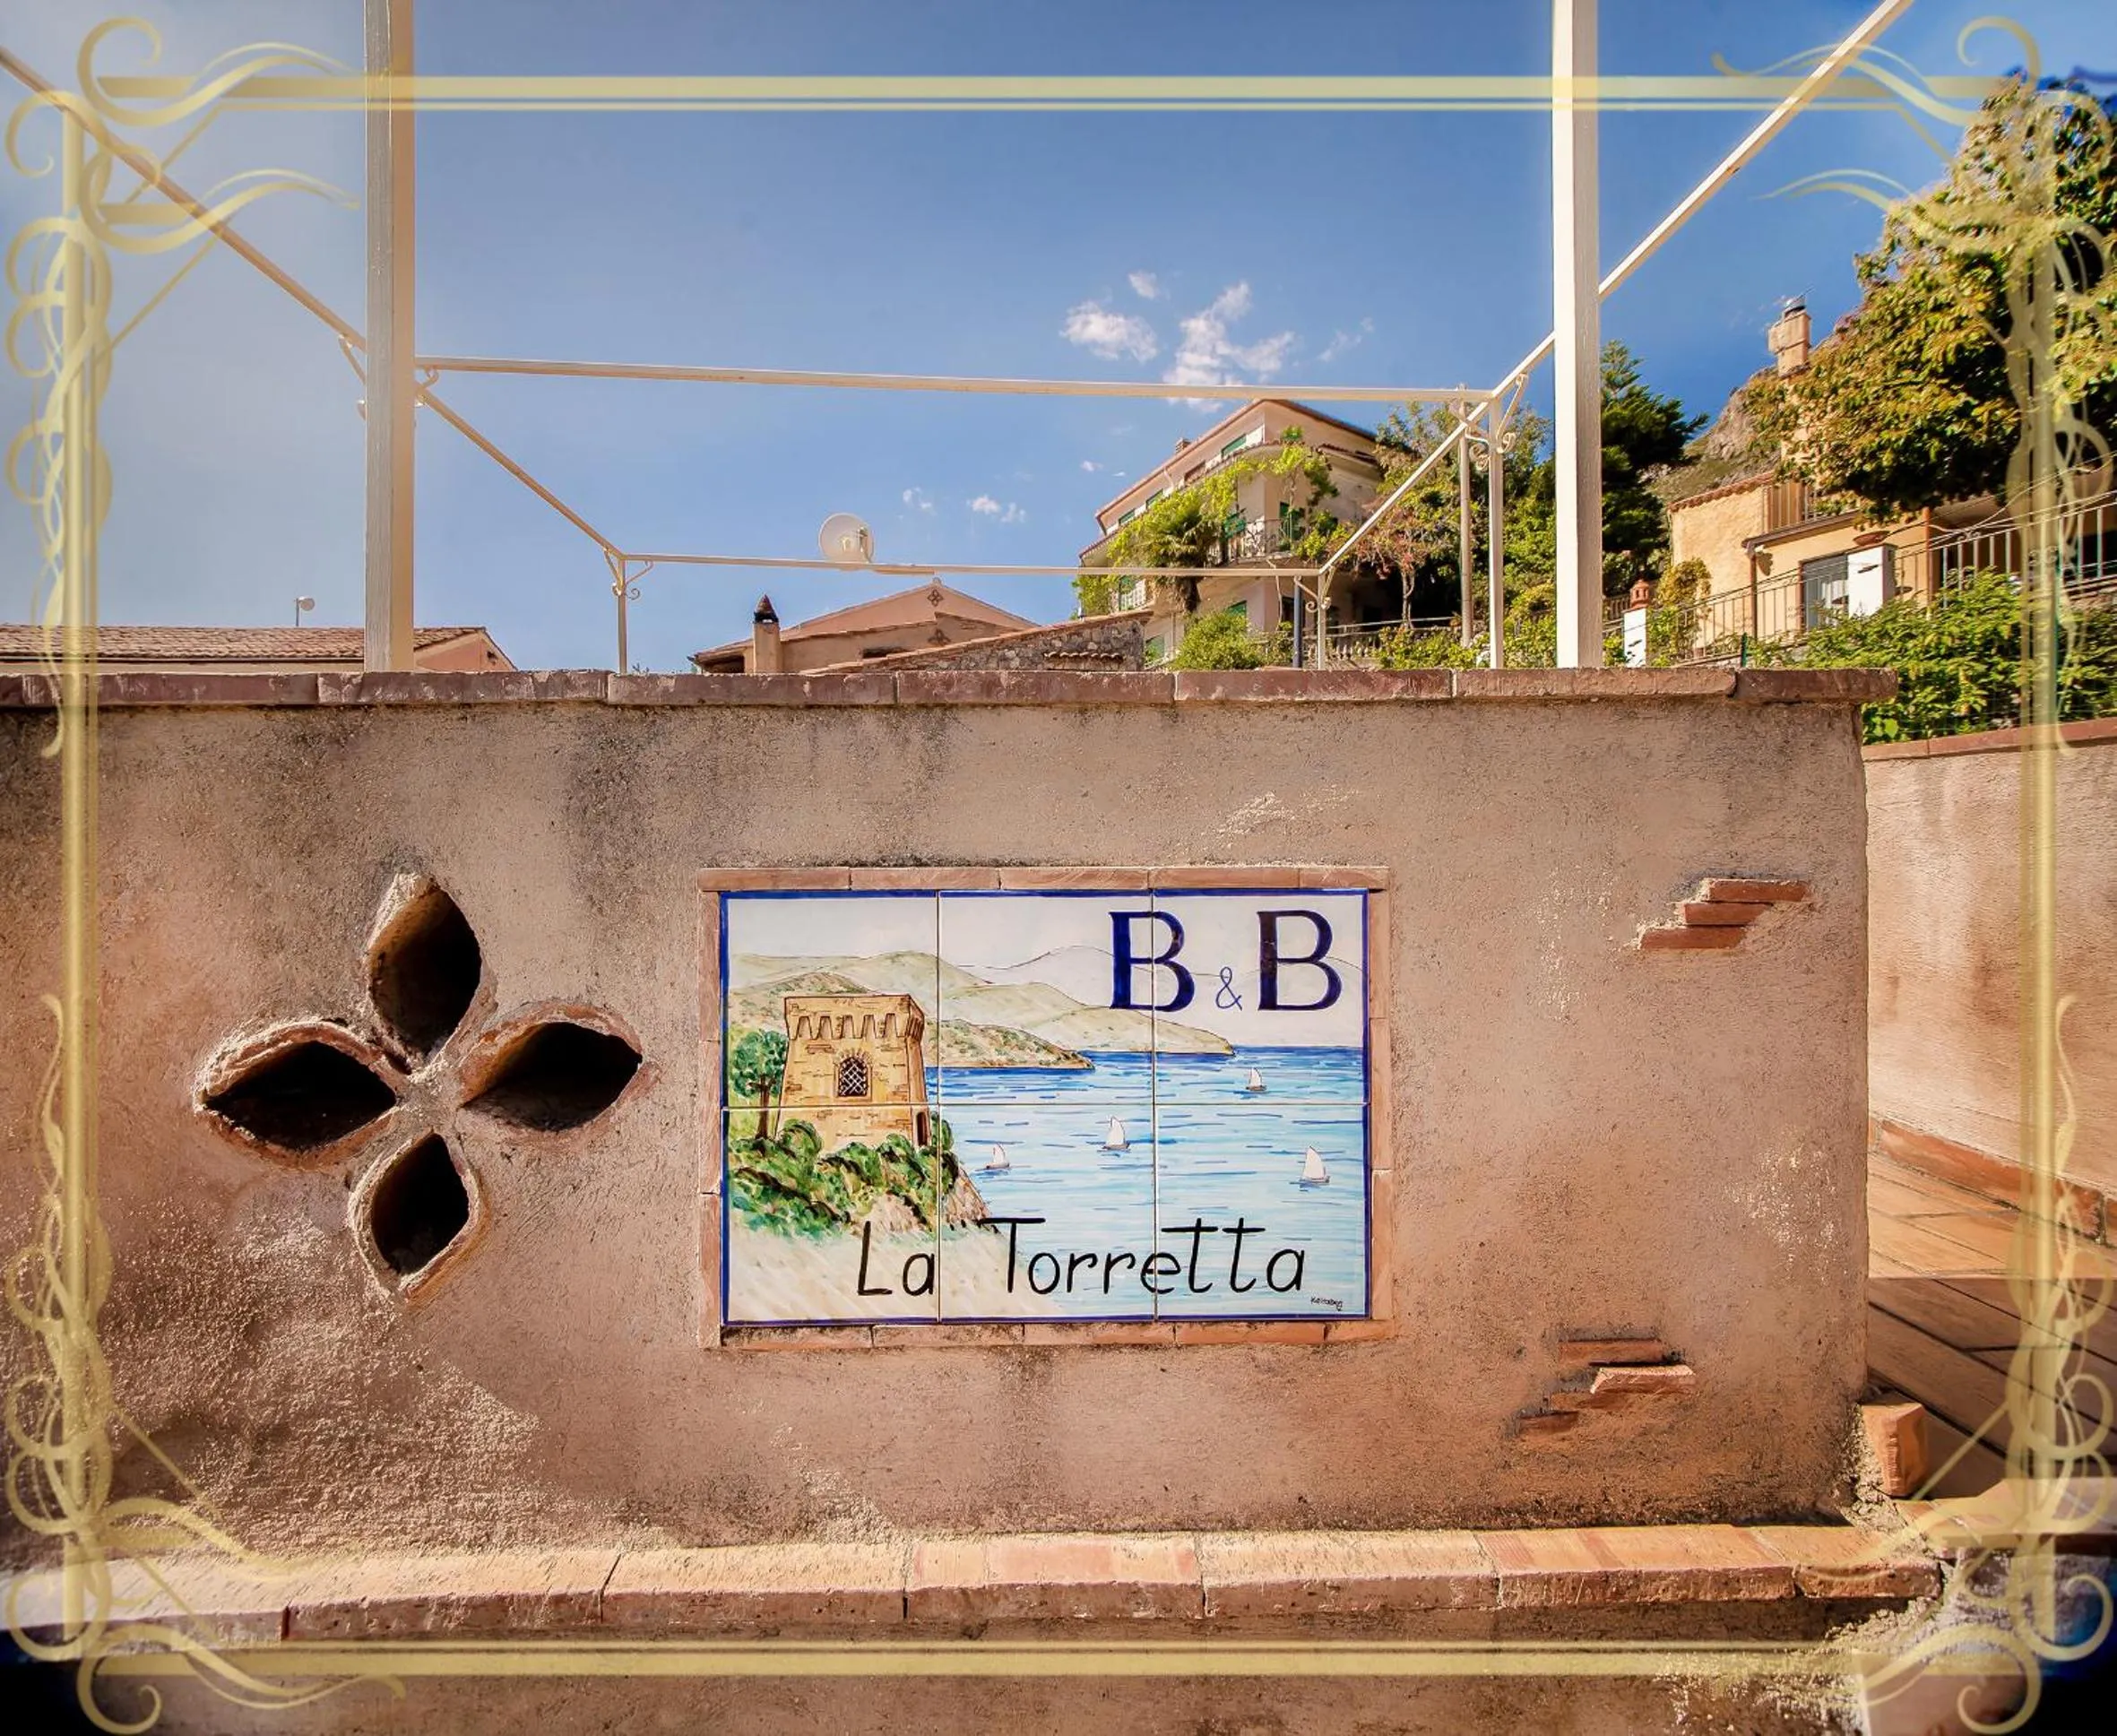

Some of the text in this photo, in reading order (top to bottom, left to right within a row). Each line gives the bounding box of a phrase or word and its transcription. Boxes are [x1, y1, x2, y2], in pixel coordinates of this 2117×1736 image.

[1109, 910, 1343, 1012] B&B
[857, 1216, 1306, 1296] La Torretta
